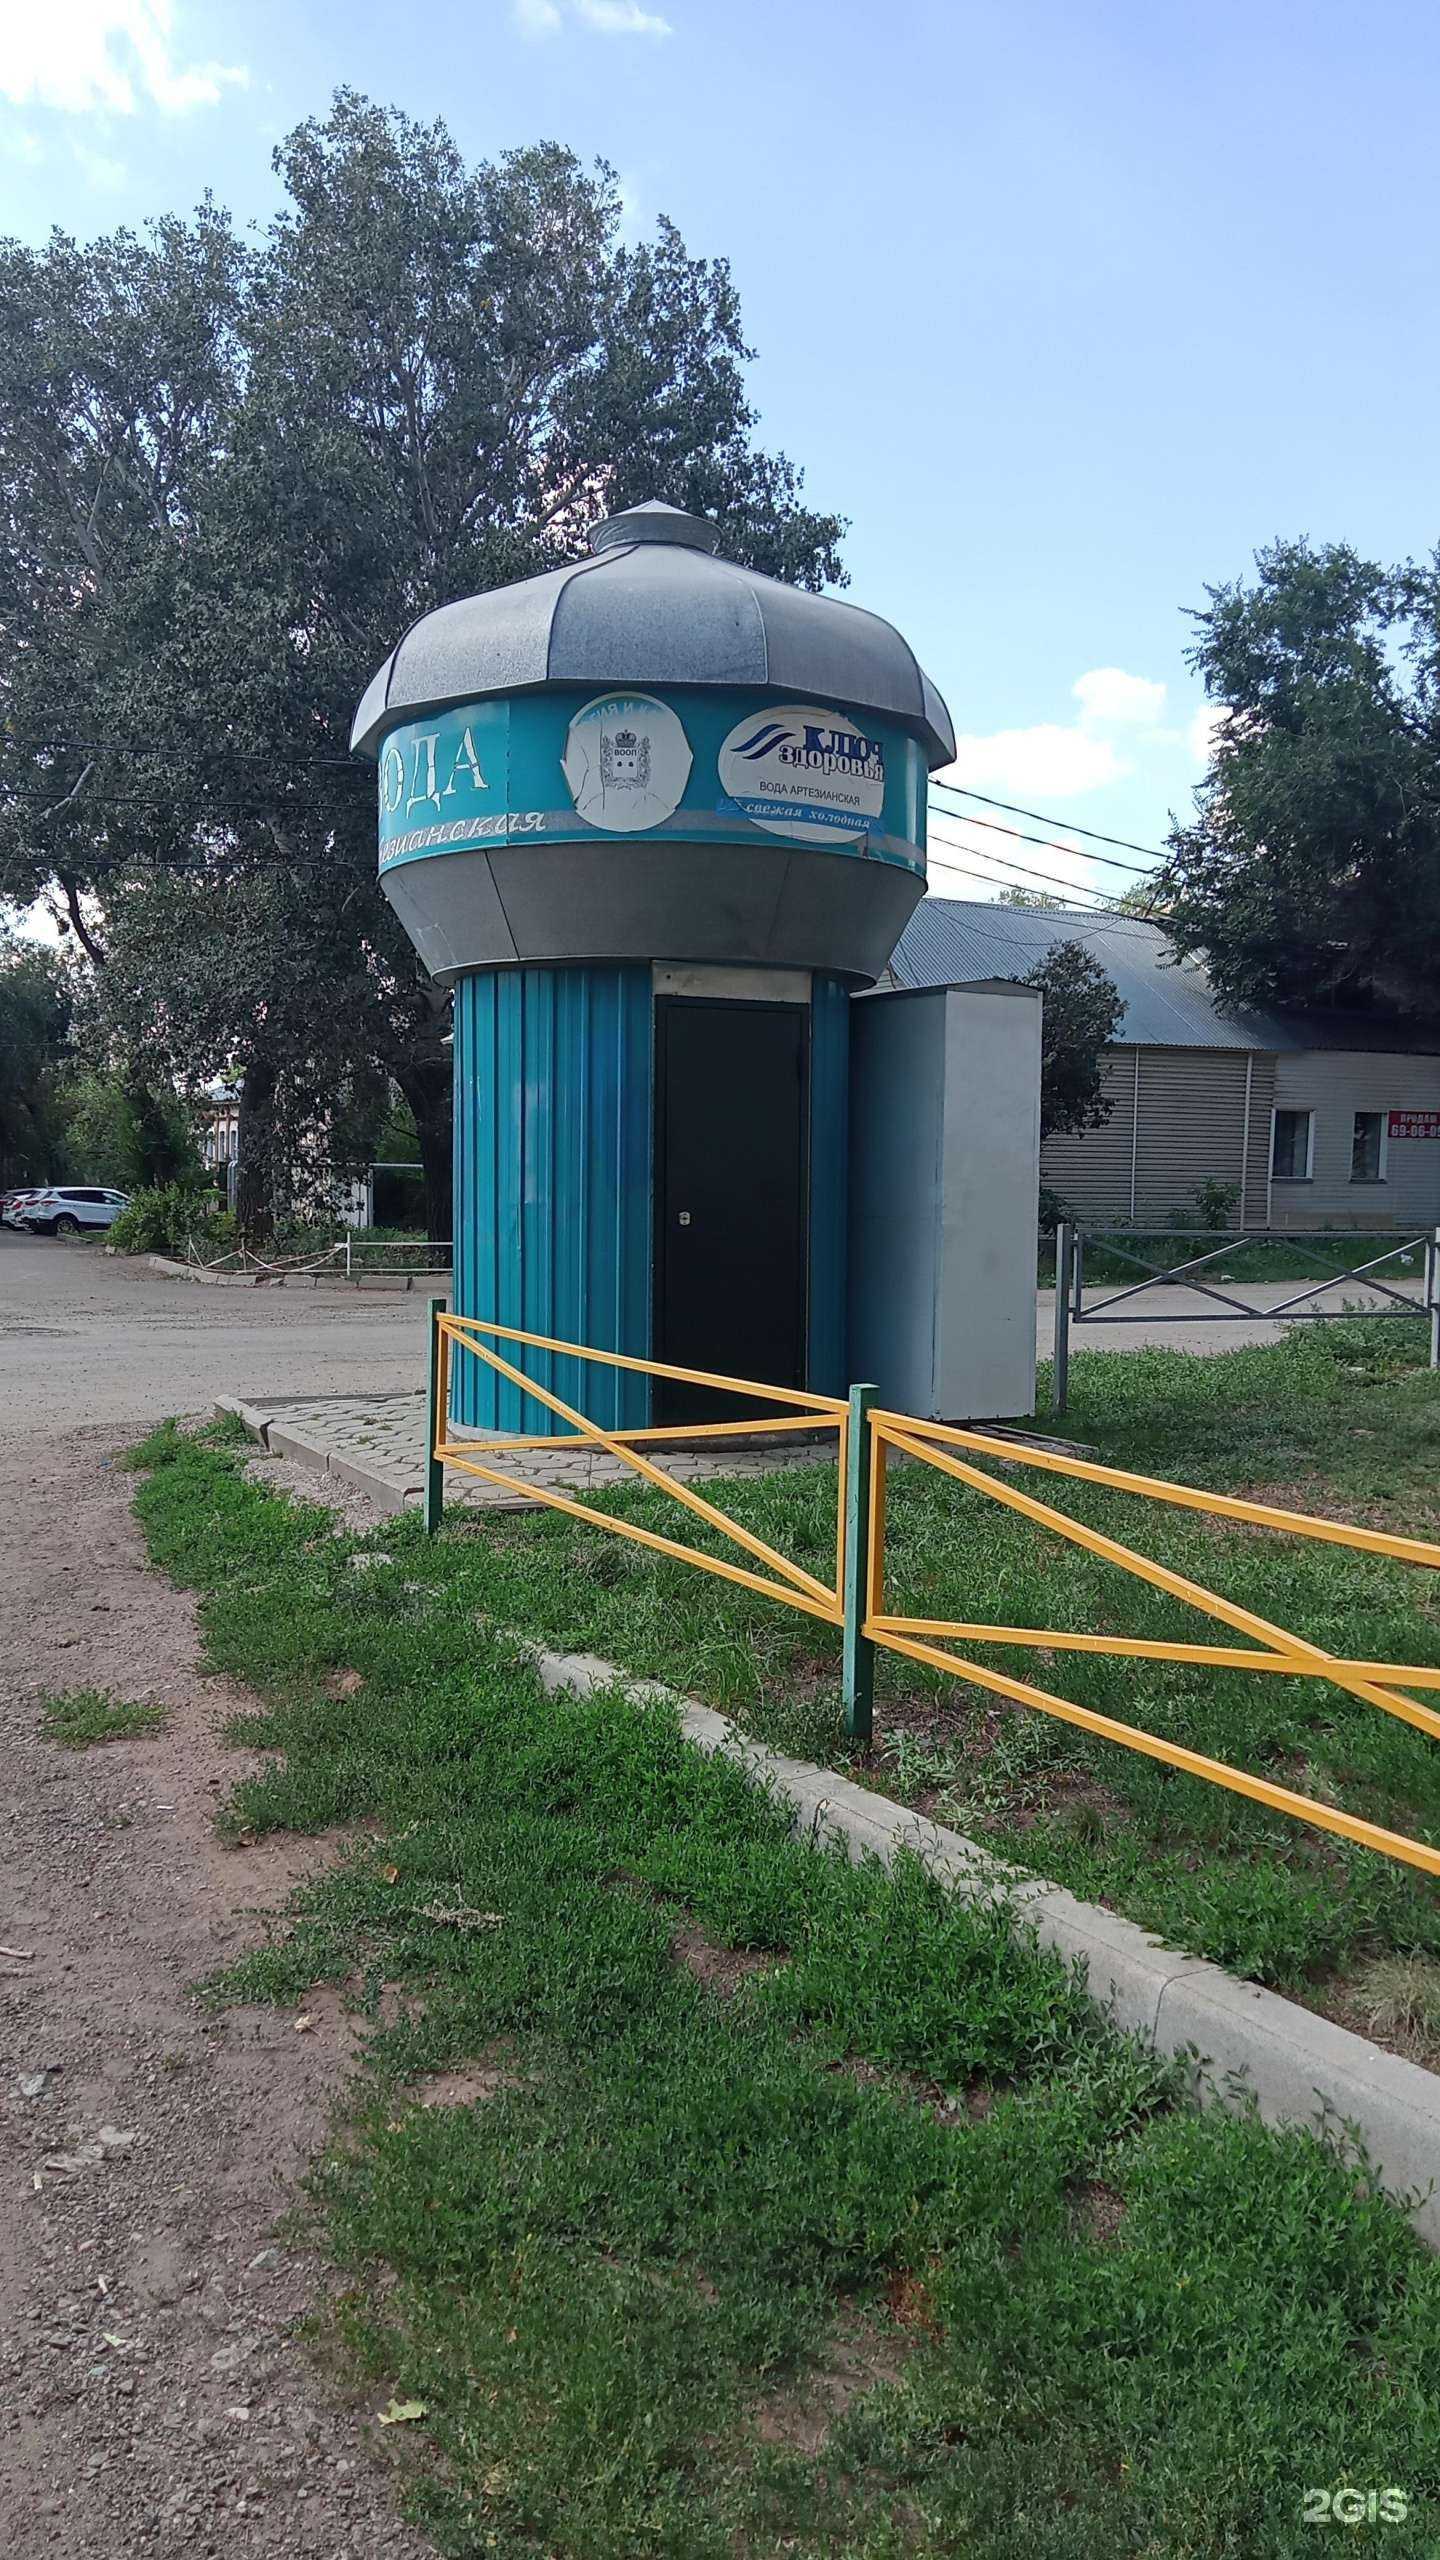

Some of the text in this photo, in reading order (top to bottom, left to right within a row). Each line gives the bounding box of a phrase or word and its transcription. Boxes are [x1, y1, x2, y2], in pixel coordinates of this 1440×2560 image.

[614, 749, 637, 757] ВООП
[378, 727, 489, 820] ОДА
[759, 781, 860, 806] ВОДА АРТЕЗИАНСКАЯ
[746, 803, 870, 829] свежая холодная
